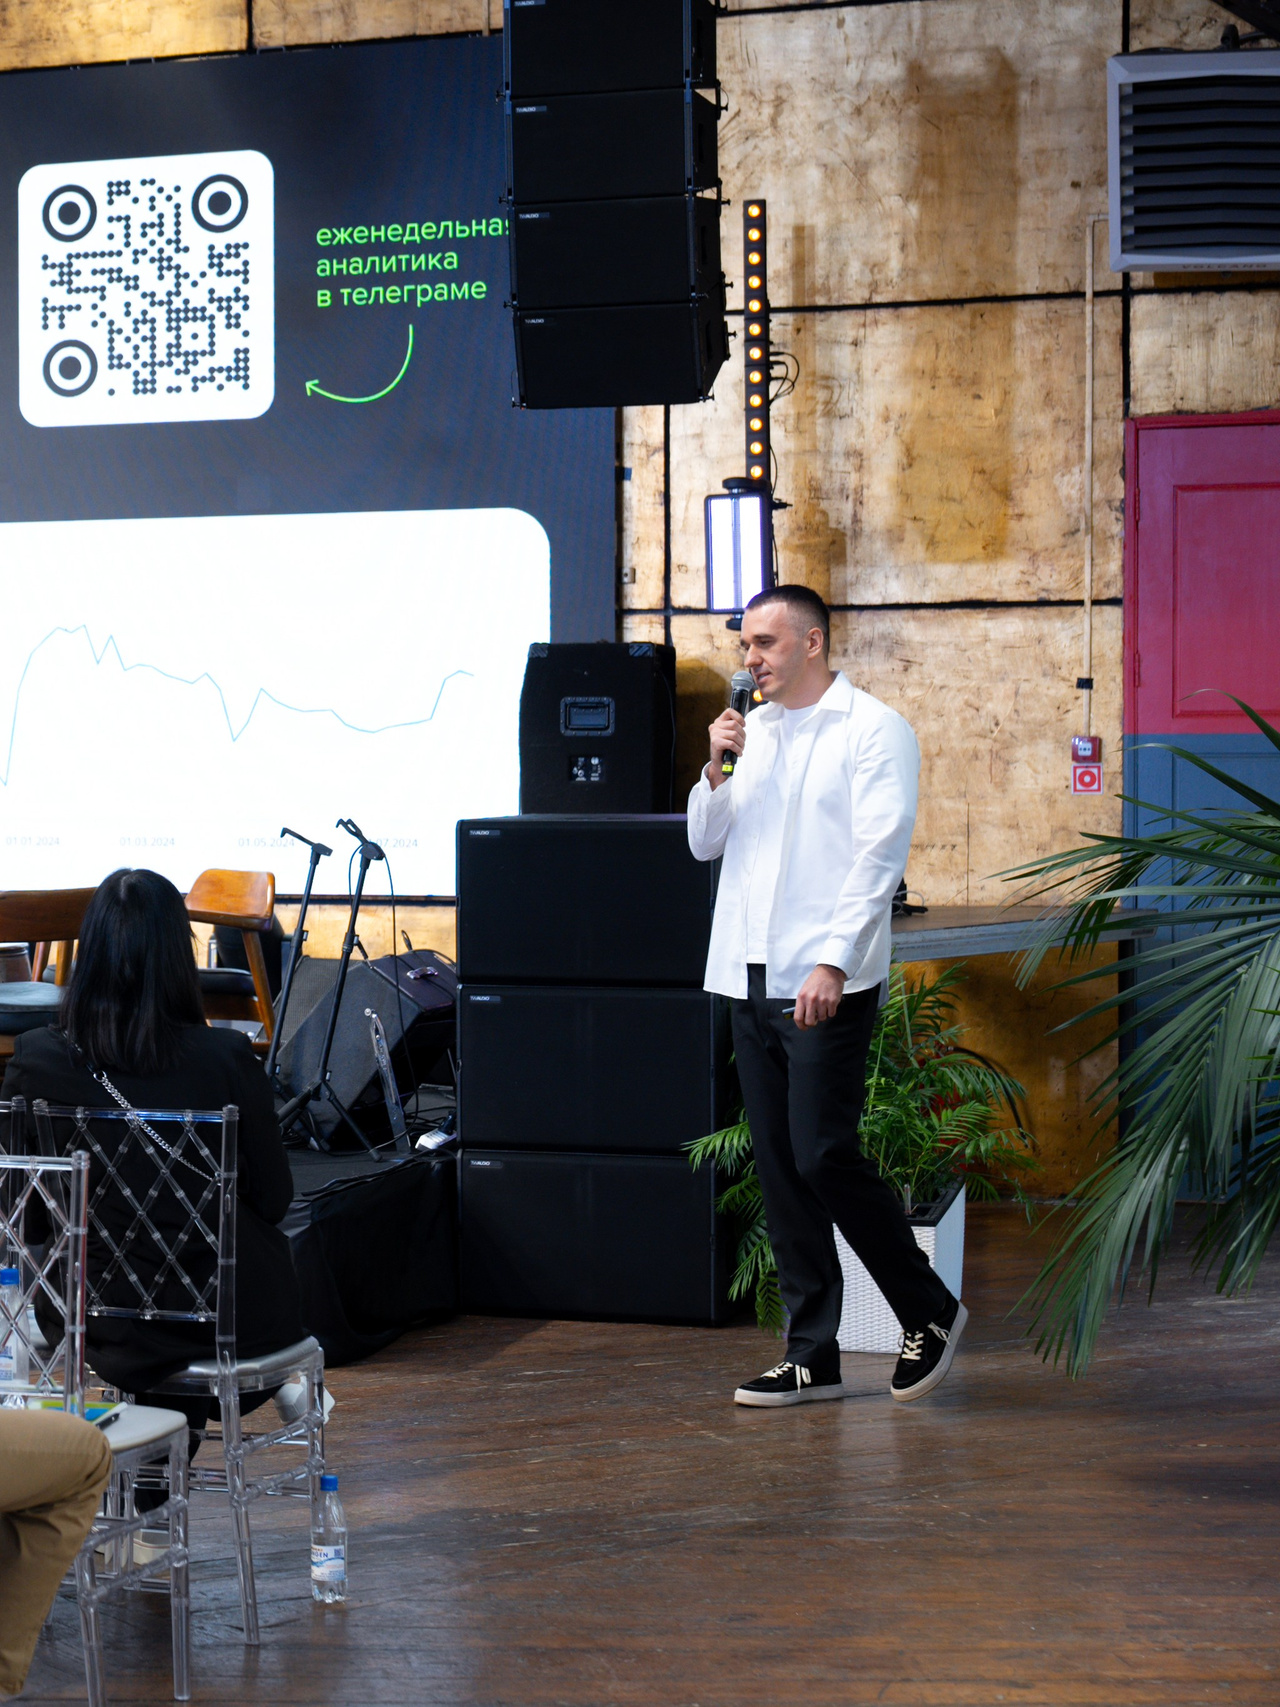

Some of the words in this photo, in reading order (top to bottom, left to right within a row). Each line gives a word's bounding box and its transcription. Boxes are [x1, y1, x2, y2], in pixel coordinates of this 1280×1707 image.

[316, 251, 459, 278] аналитика
[316, 289, 333, 308] в
[339, 280, 488, 309] телеграме
[5, 836, 61, 848] 01.01.2024
[119, 836, 176, 848] 01.03.2024
[237, 837, 295, 848] 01.05.2024
